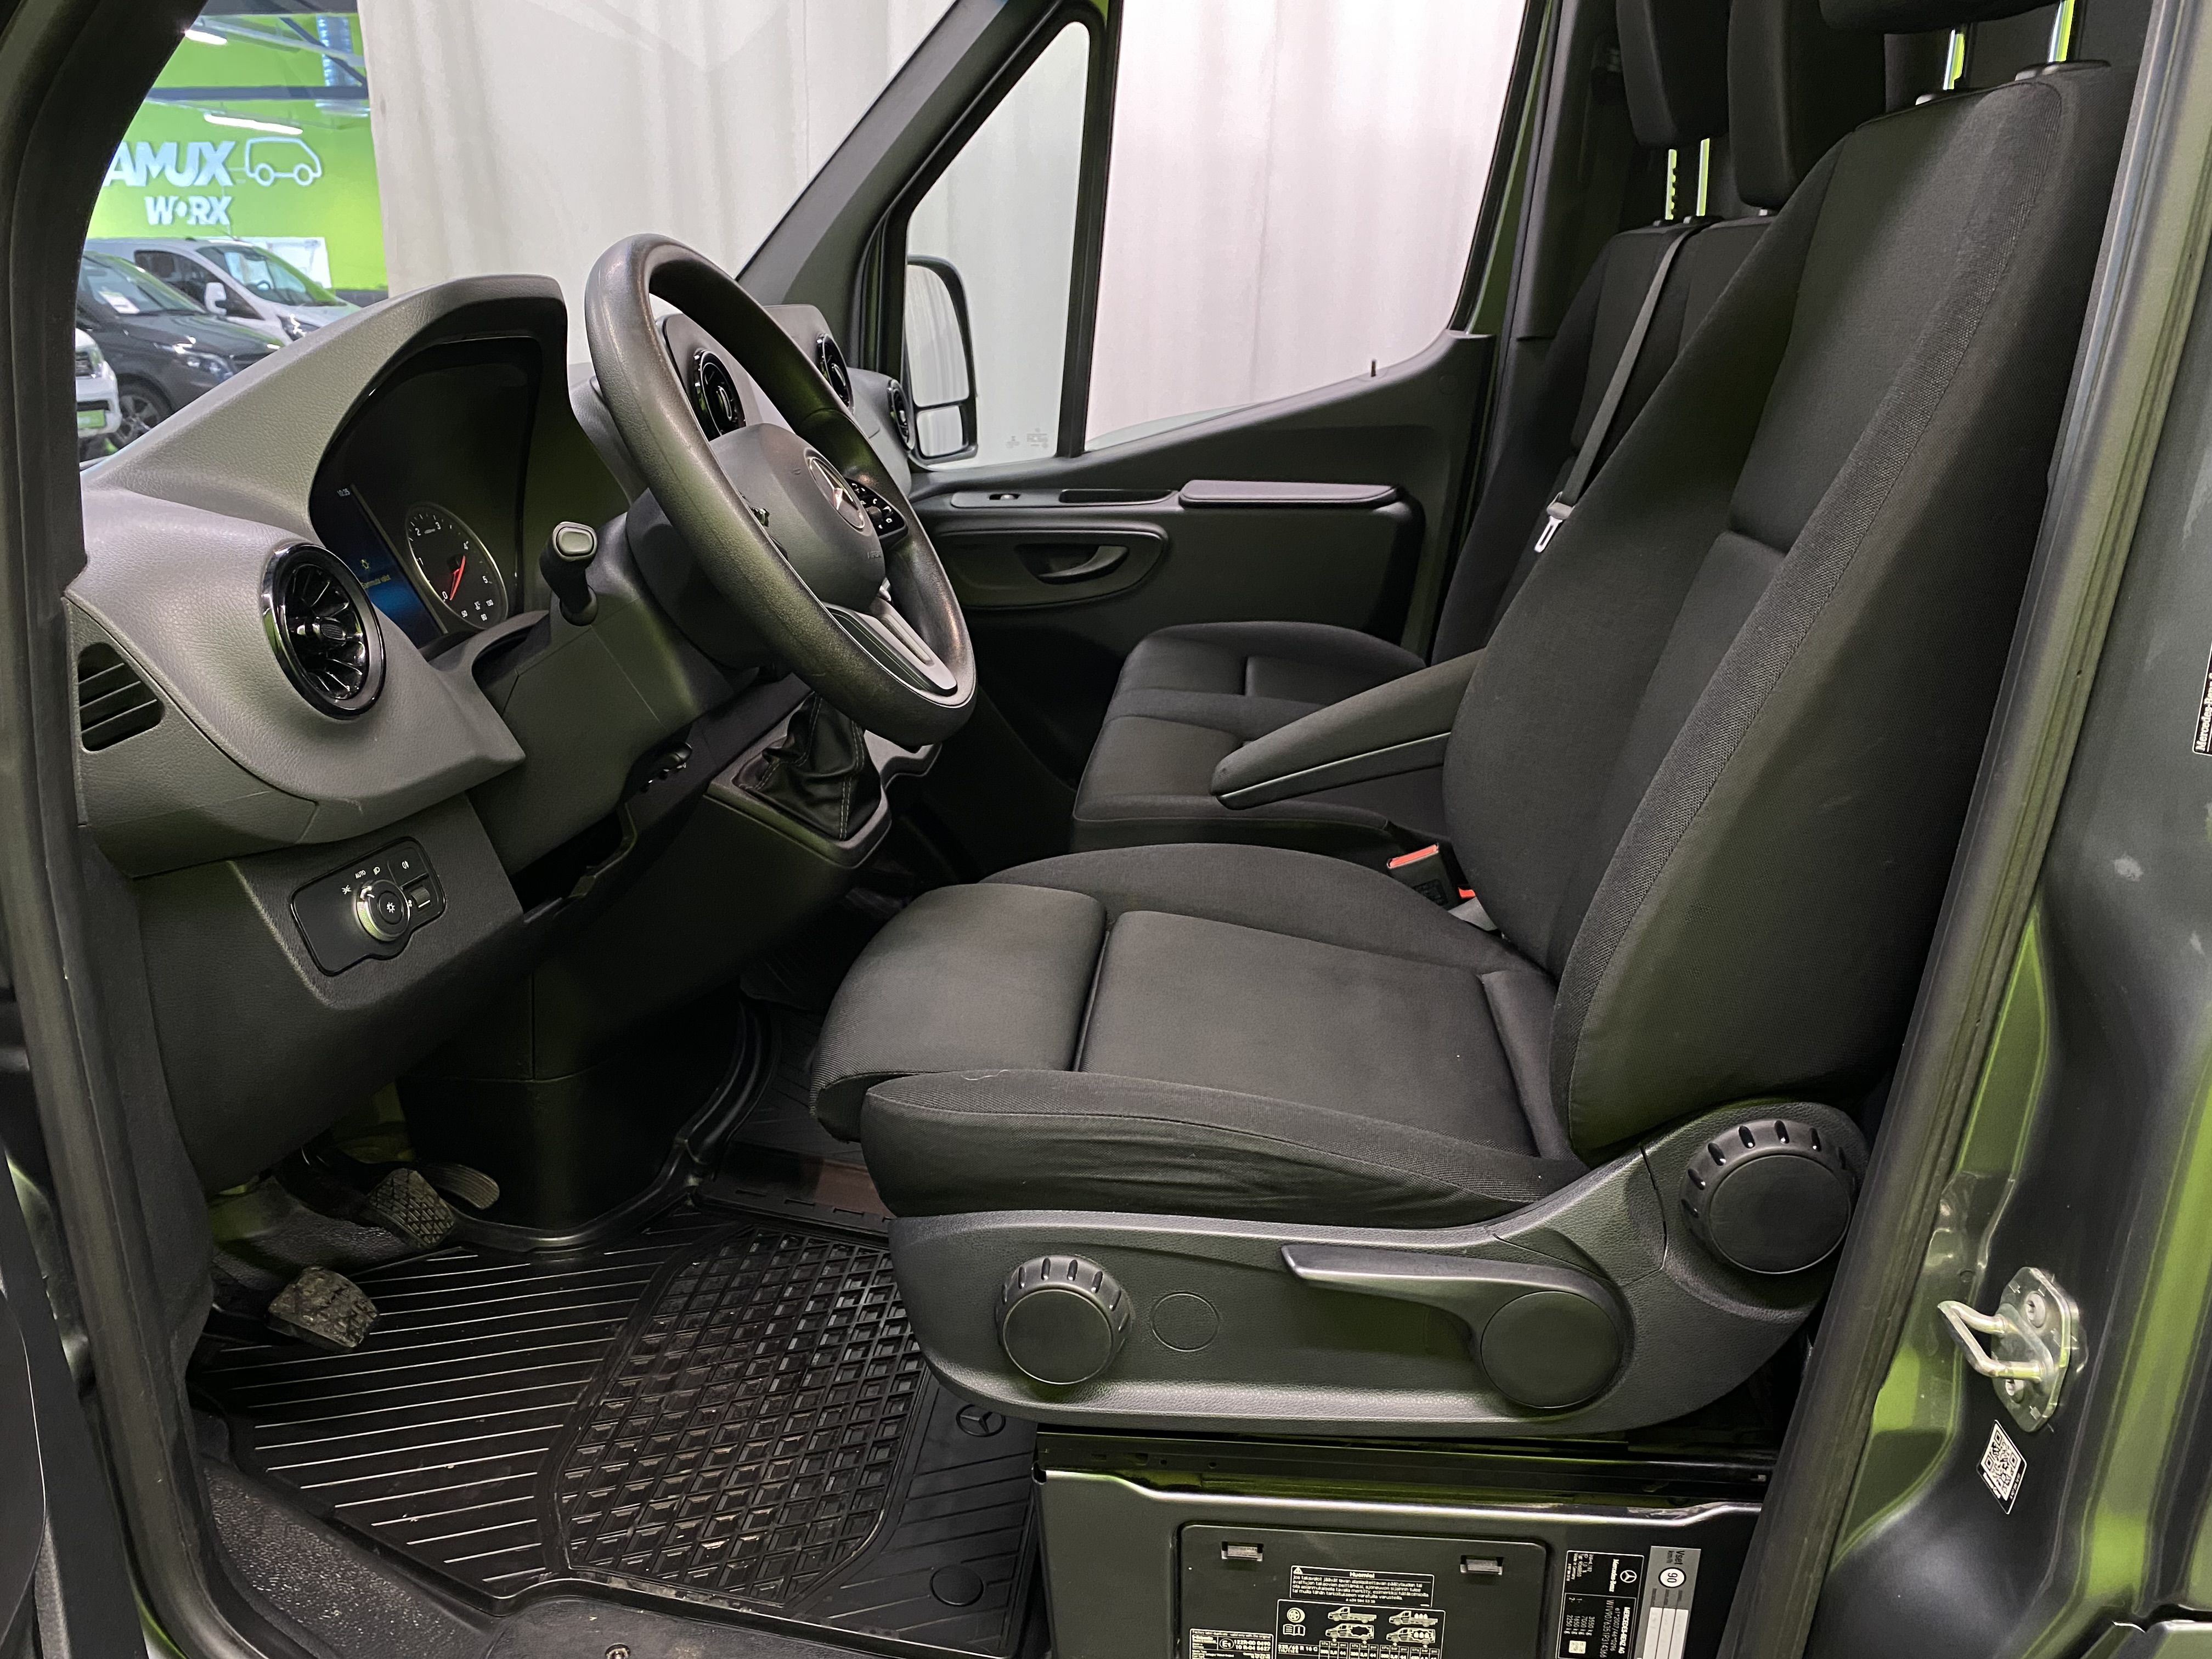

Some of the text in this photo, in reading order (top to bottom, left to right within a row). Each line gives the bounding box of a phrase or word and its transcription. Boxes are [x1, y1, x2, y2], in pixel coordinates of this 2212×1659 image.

[464, 541, 469, 550] 4
[442, 591, 448, 599] 0
[355, 870, 366, 879] AUTO
[1674, 1550, 1685, 1565] Vset
[1609, 1559, 1619, 1592] Mercedes-Benz
[1667, 1573, 1678, 1583] 90
[1619, 1607, 1630, 1646] MERCEDES-BENZ
